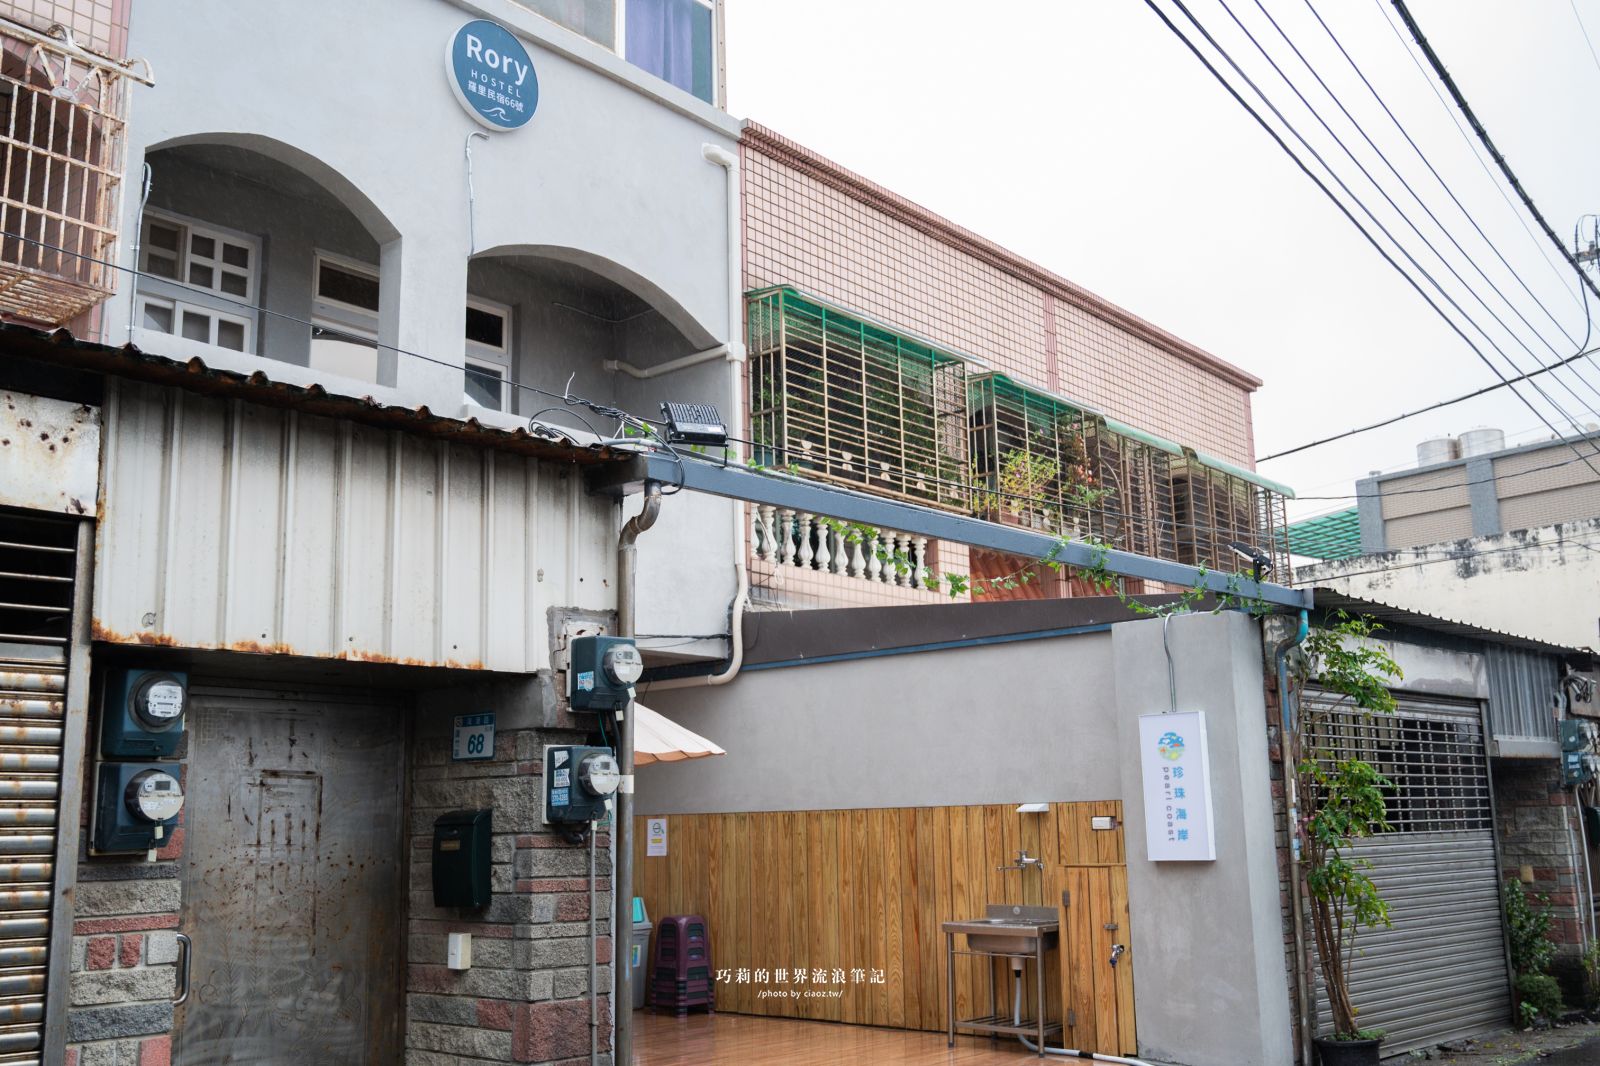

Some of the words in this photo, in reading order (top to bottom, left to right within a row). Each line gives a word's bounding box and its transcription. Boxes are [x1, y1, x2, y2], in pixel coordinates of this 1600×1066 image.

[466, 33, 528, 86] Rory
[467, 80, 524, 113] 羅里民宿66號
[471, 69, 521, 98] HOSTEL
[467, 733, 485, 755] 68
[1162, 767, 1172, 800] pearl
[1172, 766, 1189, 841] 珍珠海岸
[1166, 805, 1175, 841] coast
